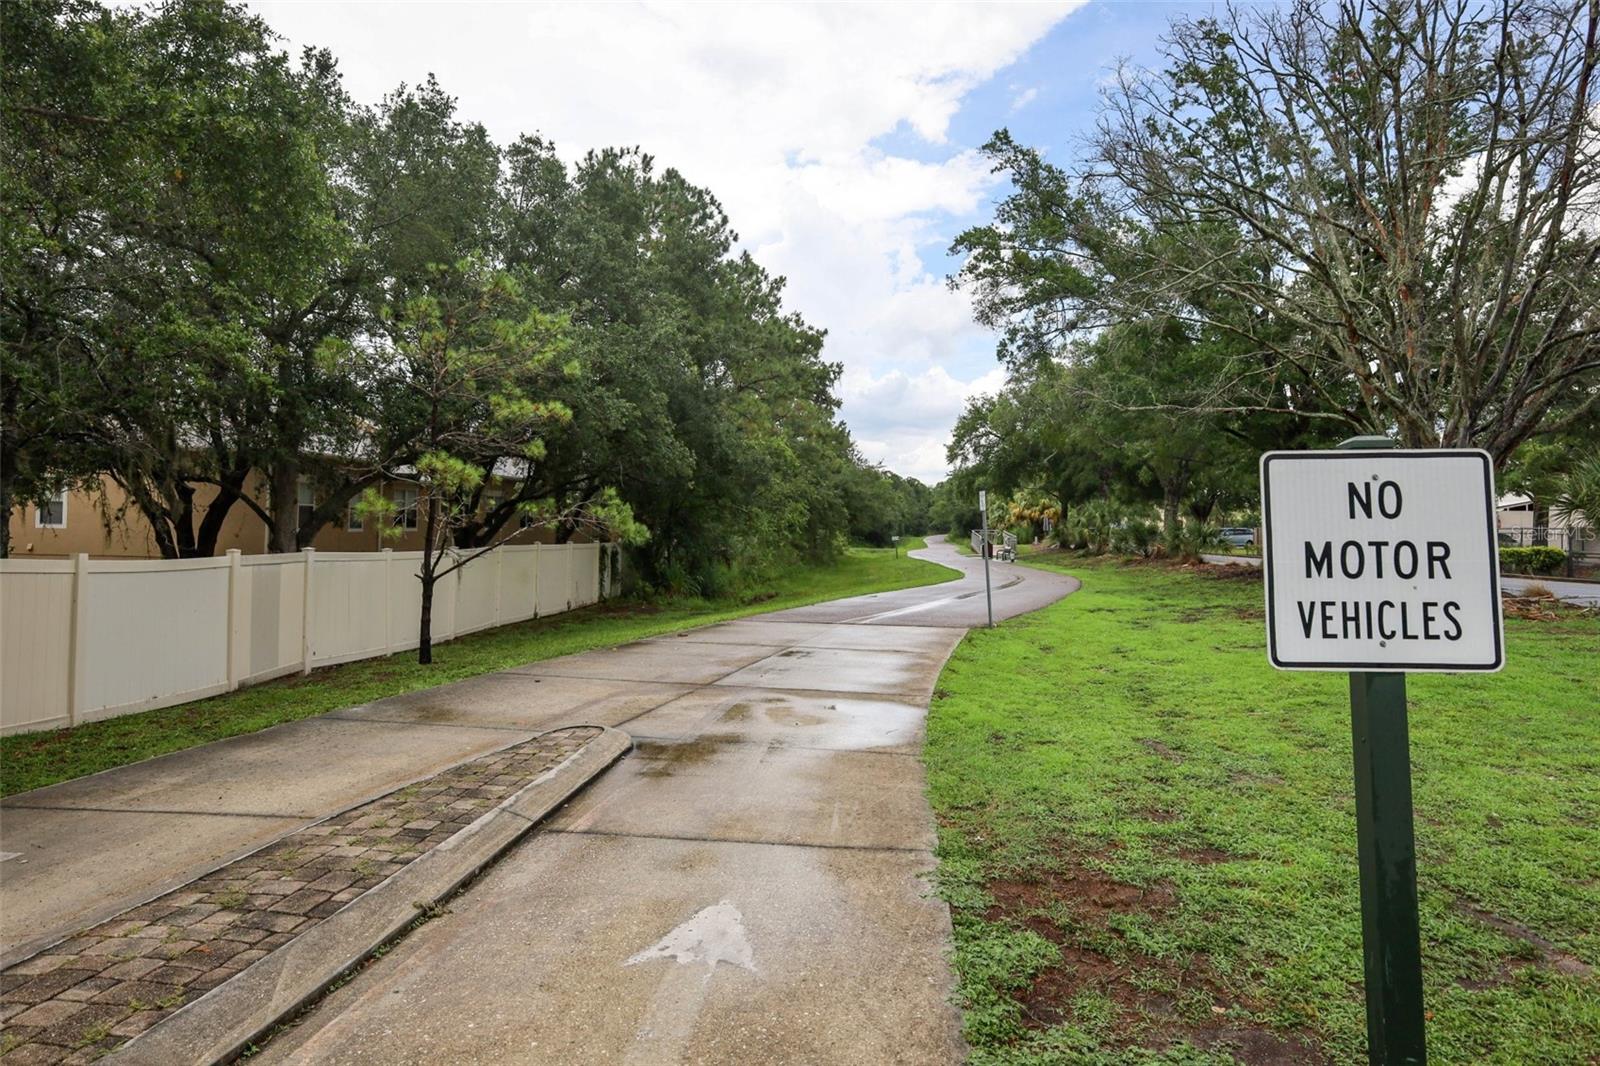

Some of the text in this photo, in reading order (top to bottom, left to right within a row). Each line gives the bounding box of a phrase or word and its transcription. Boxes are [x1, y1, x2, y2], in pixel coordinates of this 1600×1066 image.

[1347, 480, 1403, 520] NO
[1304, 540, 1452, 580] MOTOR
[1296, 600, 1463, 641] VEHICLES
